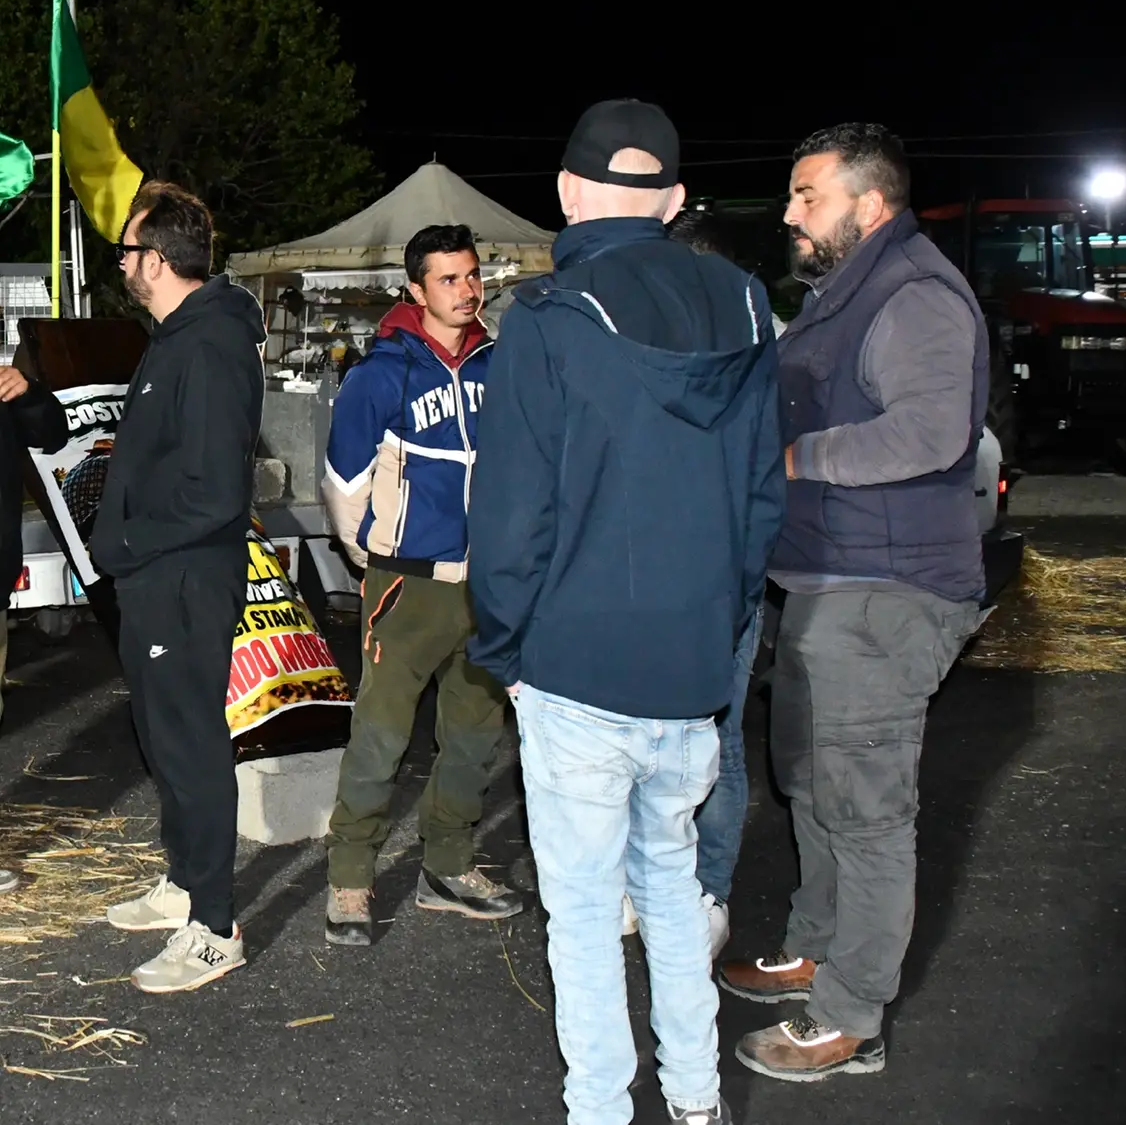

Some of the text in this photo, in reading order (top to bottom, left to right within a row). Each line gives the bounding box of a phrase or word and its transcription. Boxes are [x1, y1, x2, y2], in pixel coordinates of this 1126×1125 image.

[64, 401, 125, 431] COST
[411, 383, 456, 433] NEW
[225, 639, 279, 706] NDO
